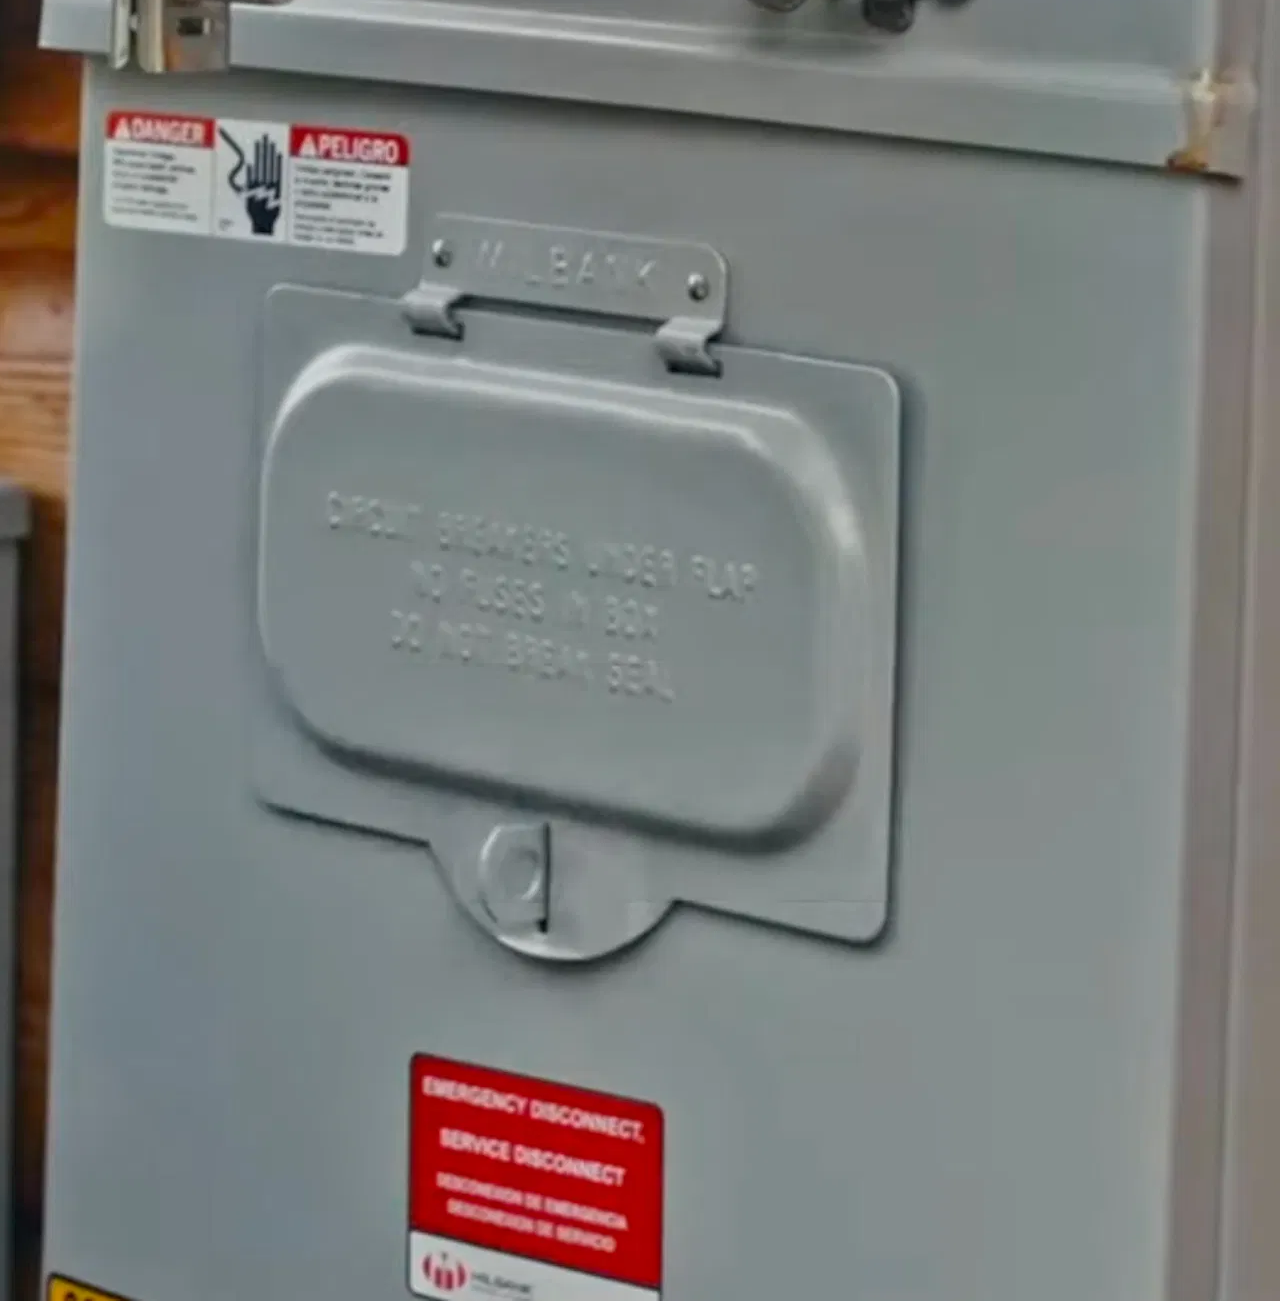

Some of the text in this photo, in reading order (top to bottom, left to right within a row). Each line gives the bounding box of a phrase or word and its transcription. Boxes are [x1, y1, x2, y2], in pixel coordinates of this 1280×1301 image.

[131, 117, 205, 145] DANGER
[317, 133, 399, 165] PELIGRO
[422, 1075, 527, 1115] EMERGENCY
[440, 1127, 627, 1187] SERVICE DISCONNECT
